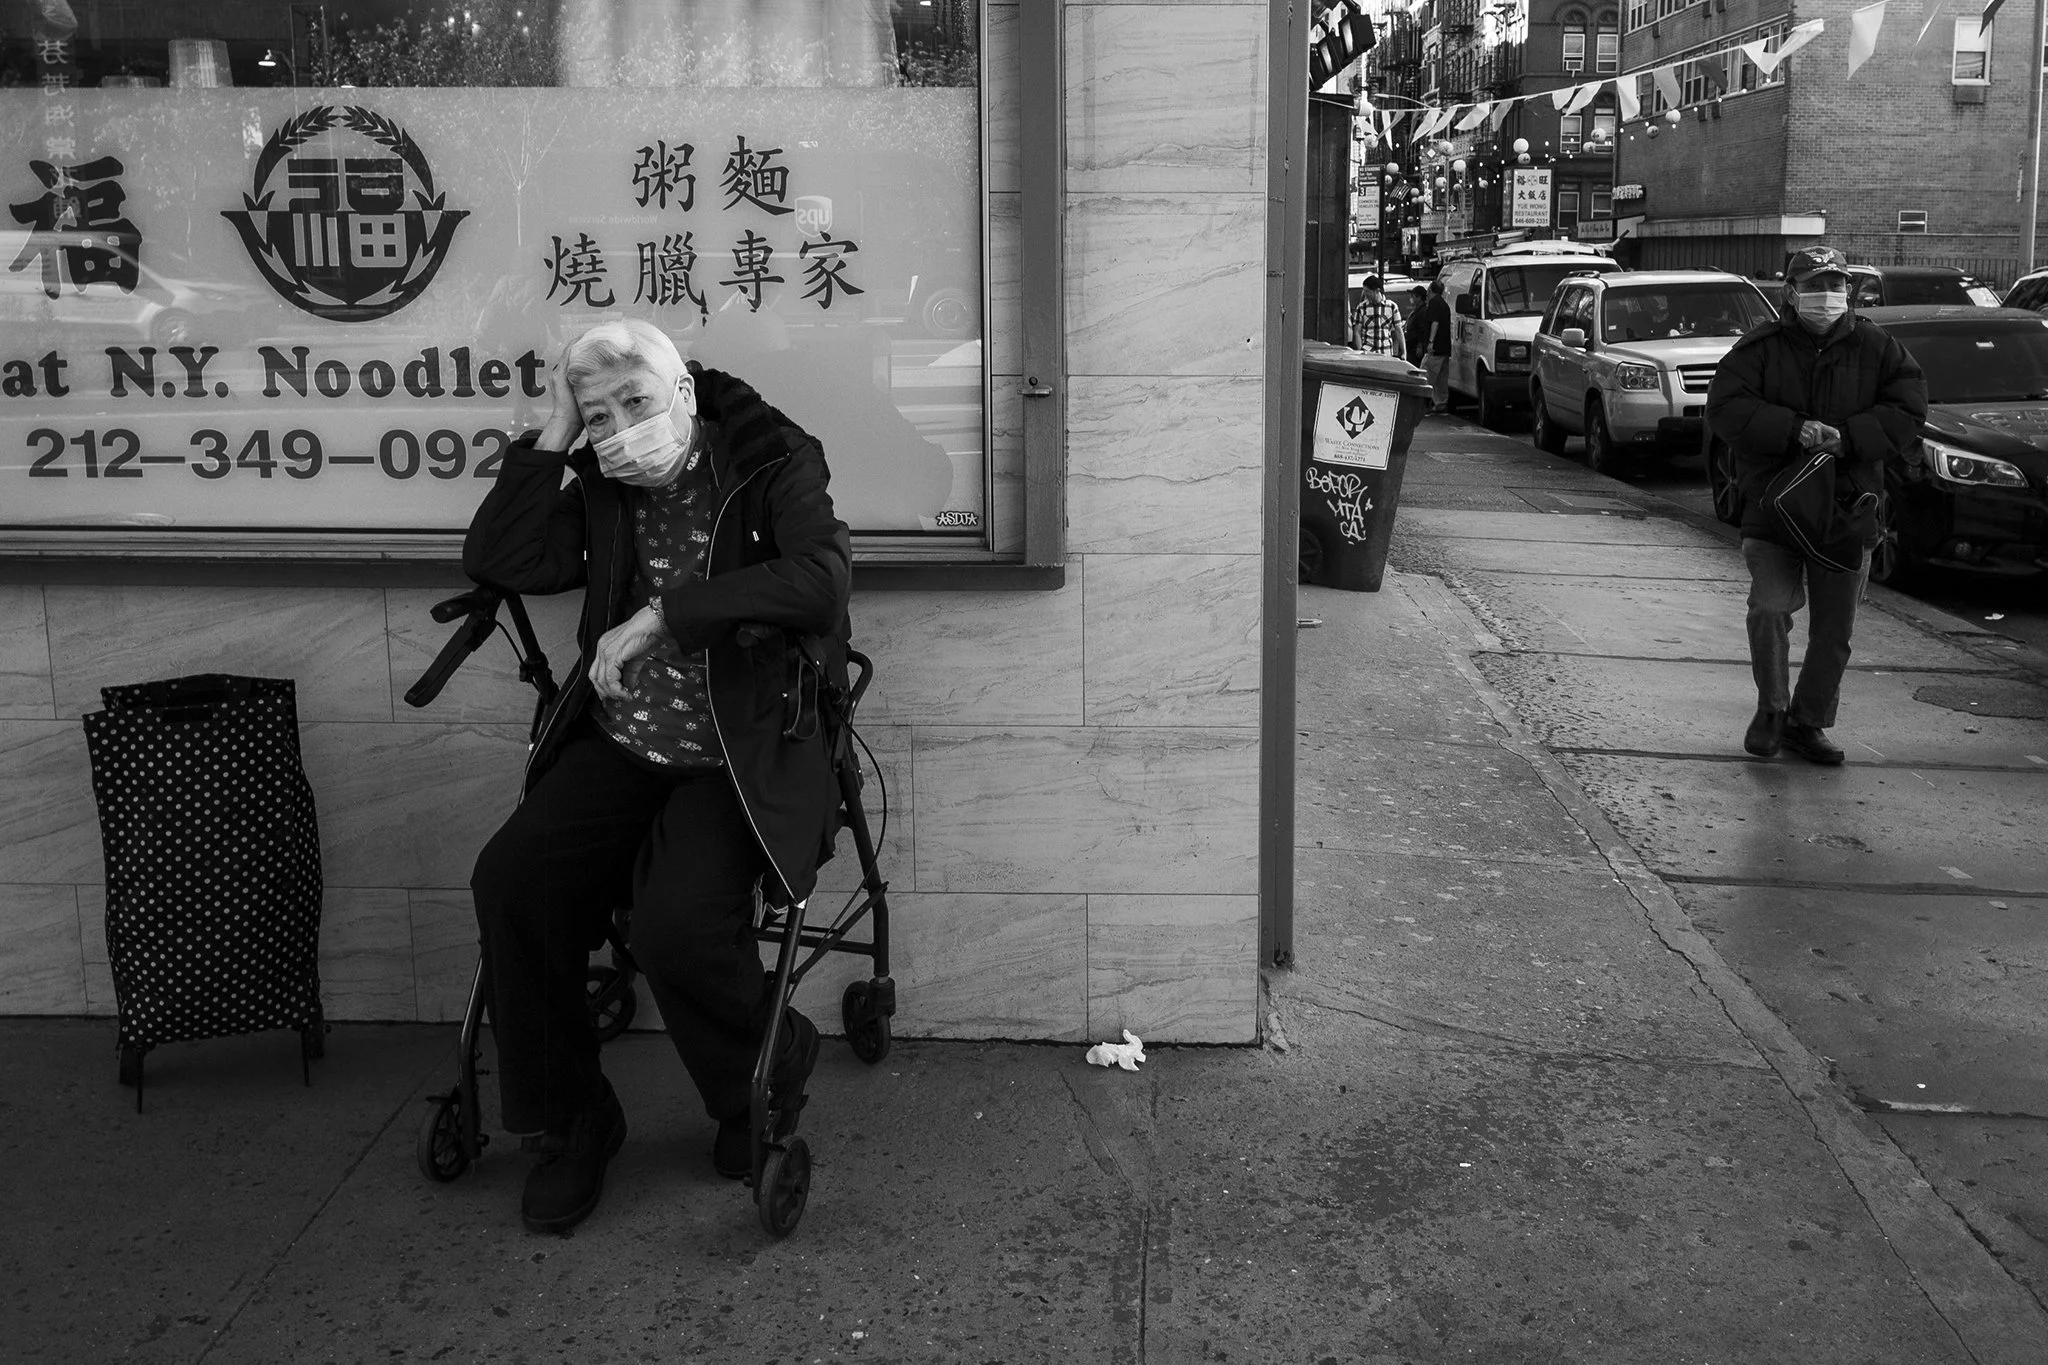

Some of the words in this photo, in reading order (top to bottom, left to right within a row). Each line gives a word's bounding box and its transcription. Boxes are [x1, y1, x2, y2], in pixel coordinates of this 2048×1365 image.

[8, 155, 142, 300] 福
[105, 346, 229, 398] N.Y.
[27, 428, 544, 480] 212-349-092
